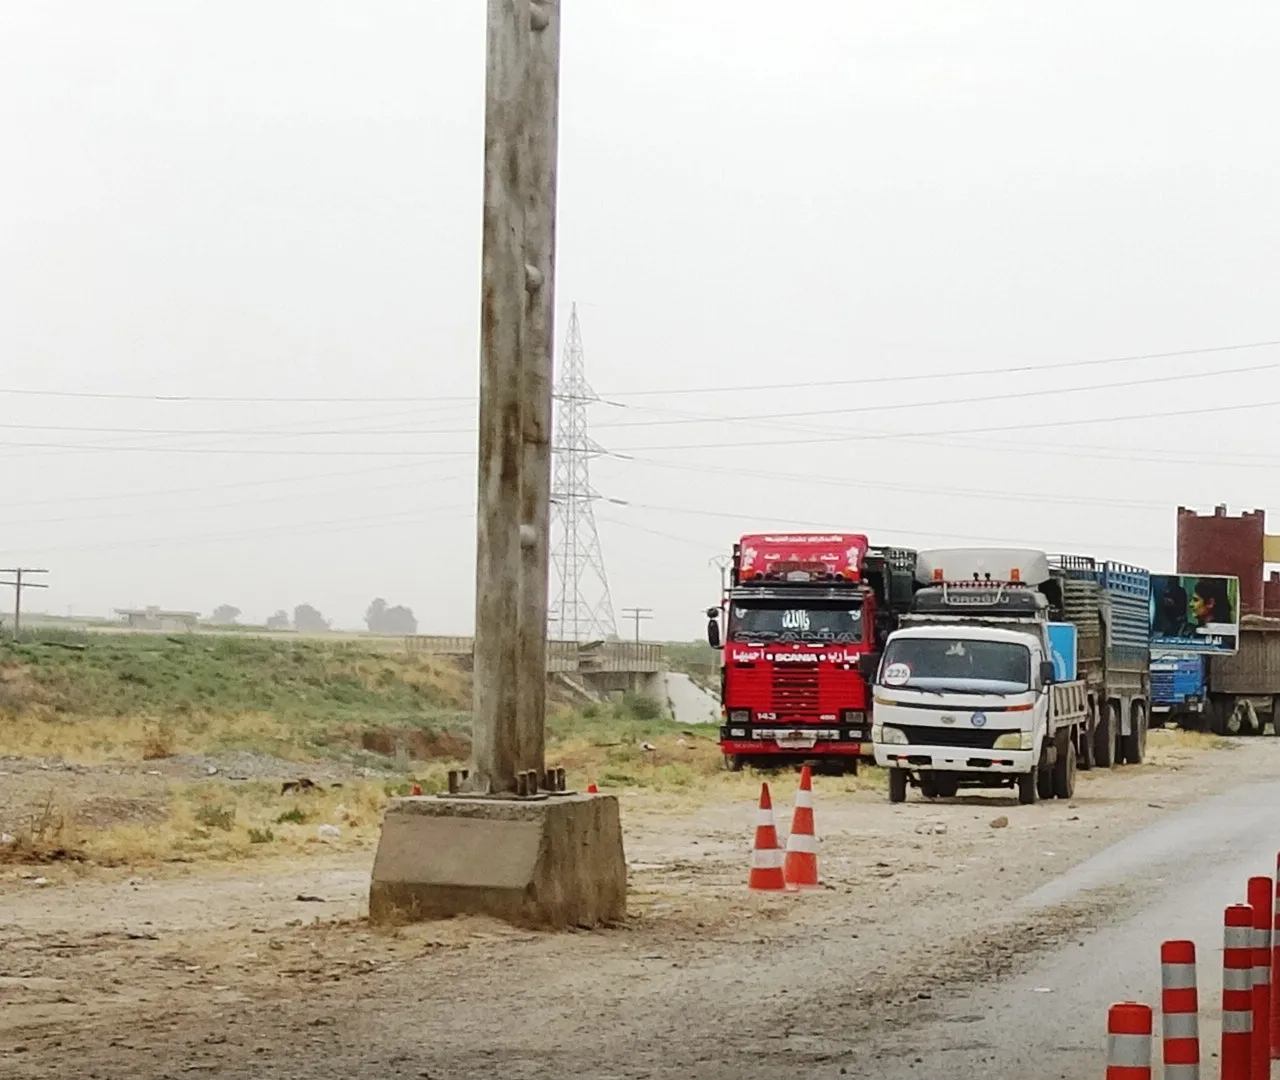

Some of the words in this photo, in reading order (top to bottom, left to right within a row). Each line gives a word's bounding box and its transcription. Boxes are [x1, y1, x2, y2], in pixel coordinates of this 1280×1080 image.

[775, 653, 818, 662] SCANIA
[887, 668, 907, 678] 225
[756, 712, 777, 720] 143
